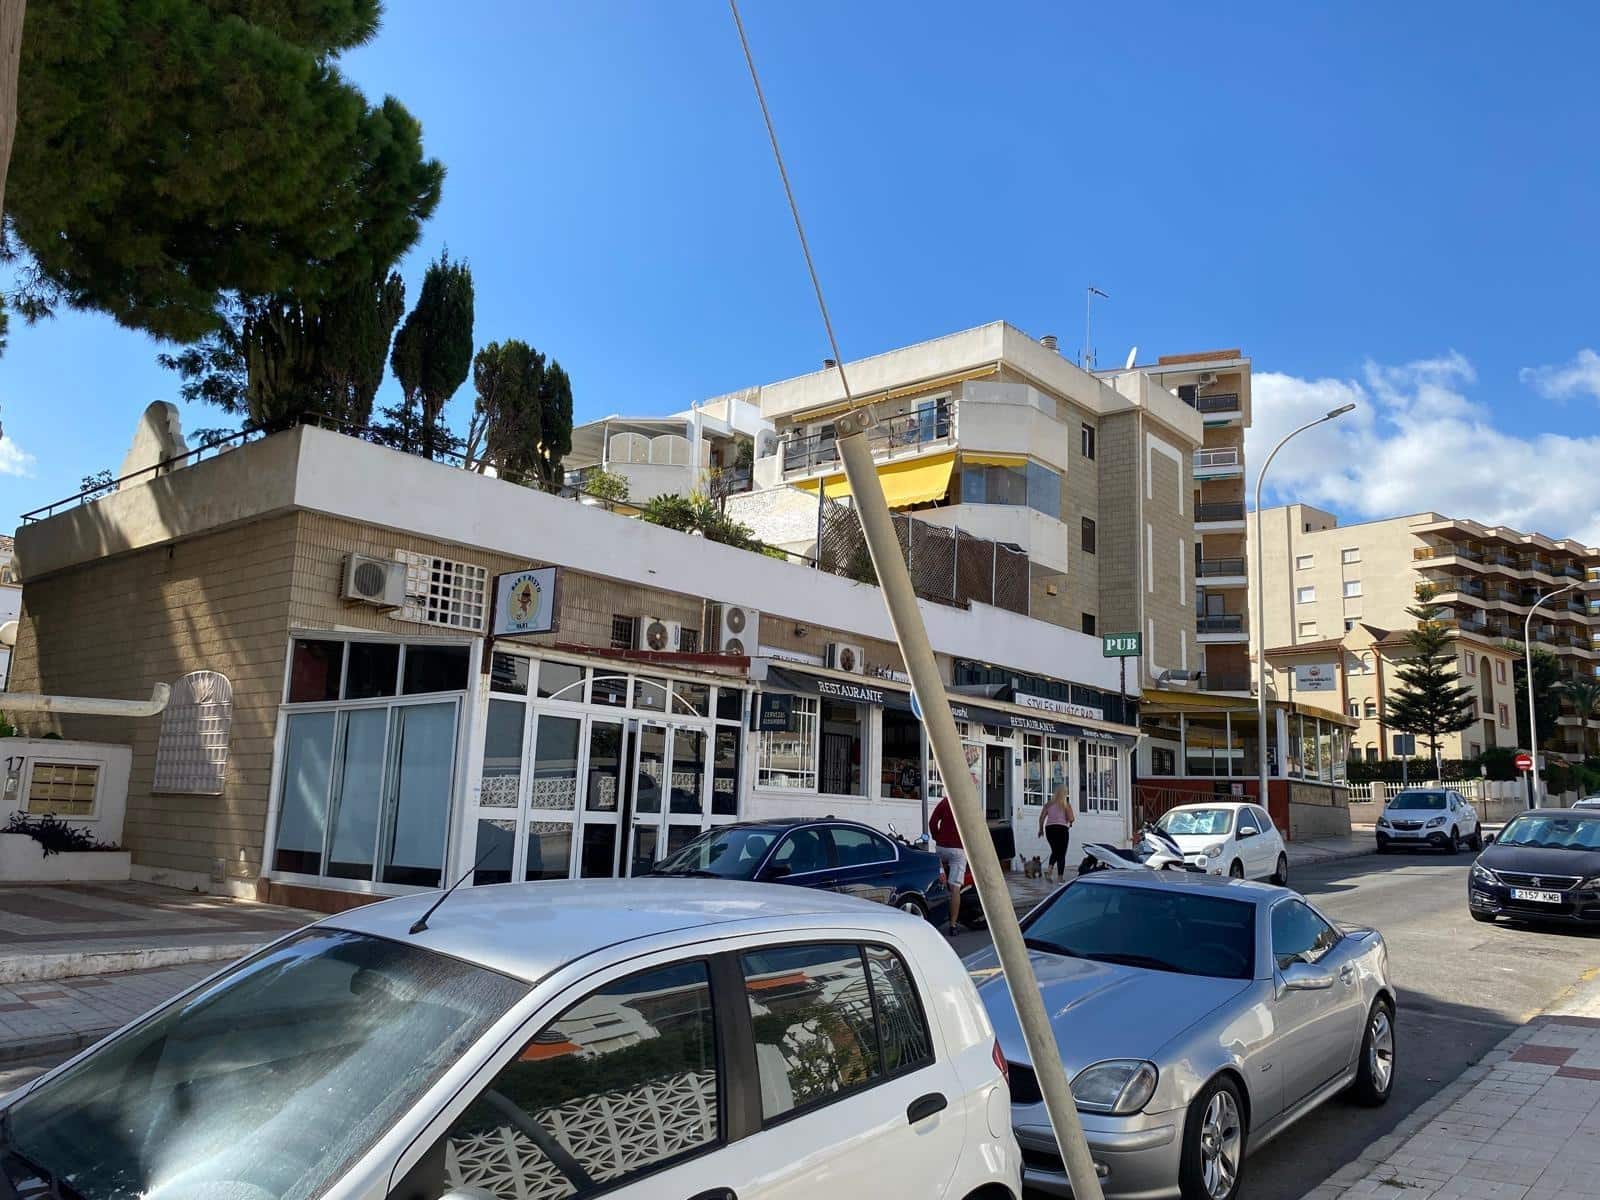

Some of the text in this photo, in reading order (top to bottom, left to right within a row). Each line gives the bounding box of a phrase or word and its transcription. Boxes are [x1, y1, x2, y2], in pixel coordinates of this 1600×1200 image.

[1106, 638, 1137, 650] PUB
[817, 681, 883, 703] RESTAURANTE
[1010, 716, 1057, 733] RESTAURANTE
[5, 756, 25, 771] 17
[1518, 891, 1539, 900] 2157
